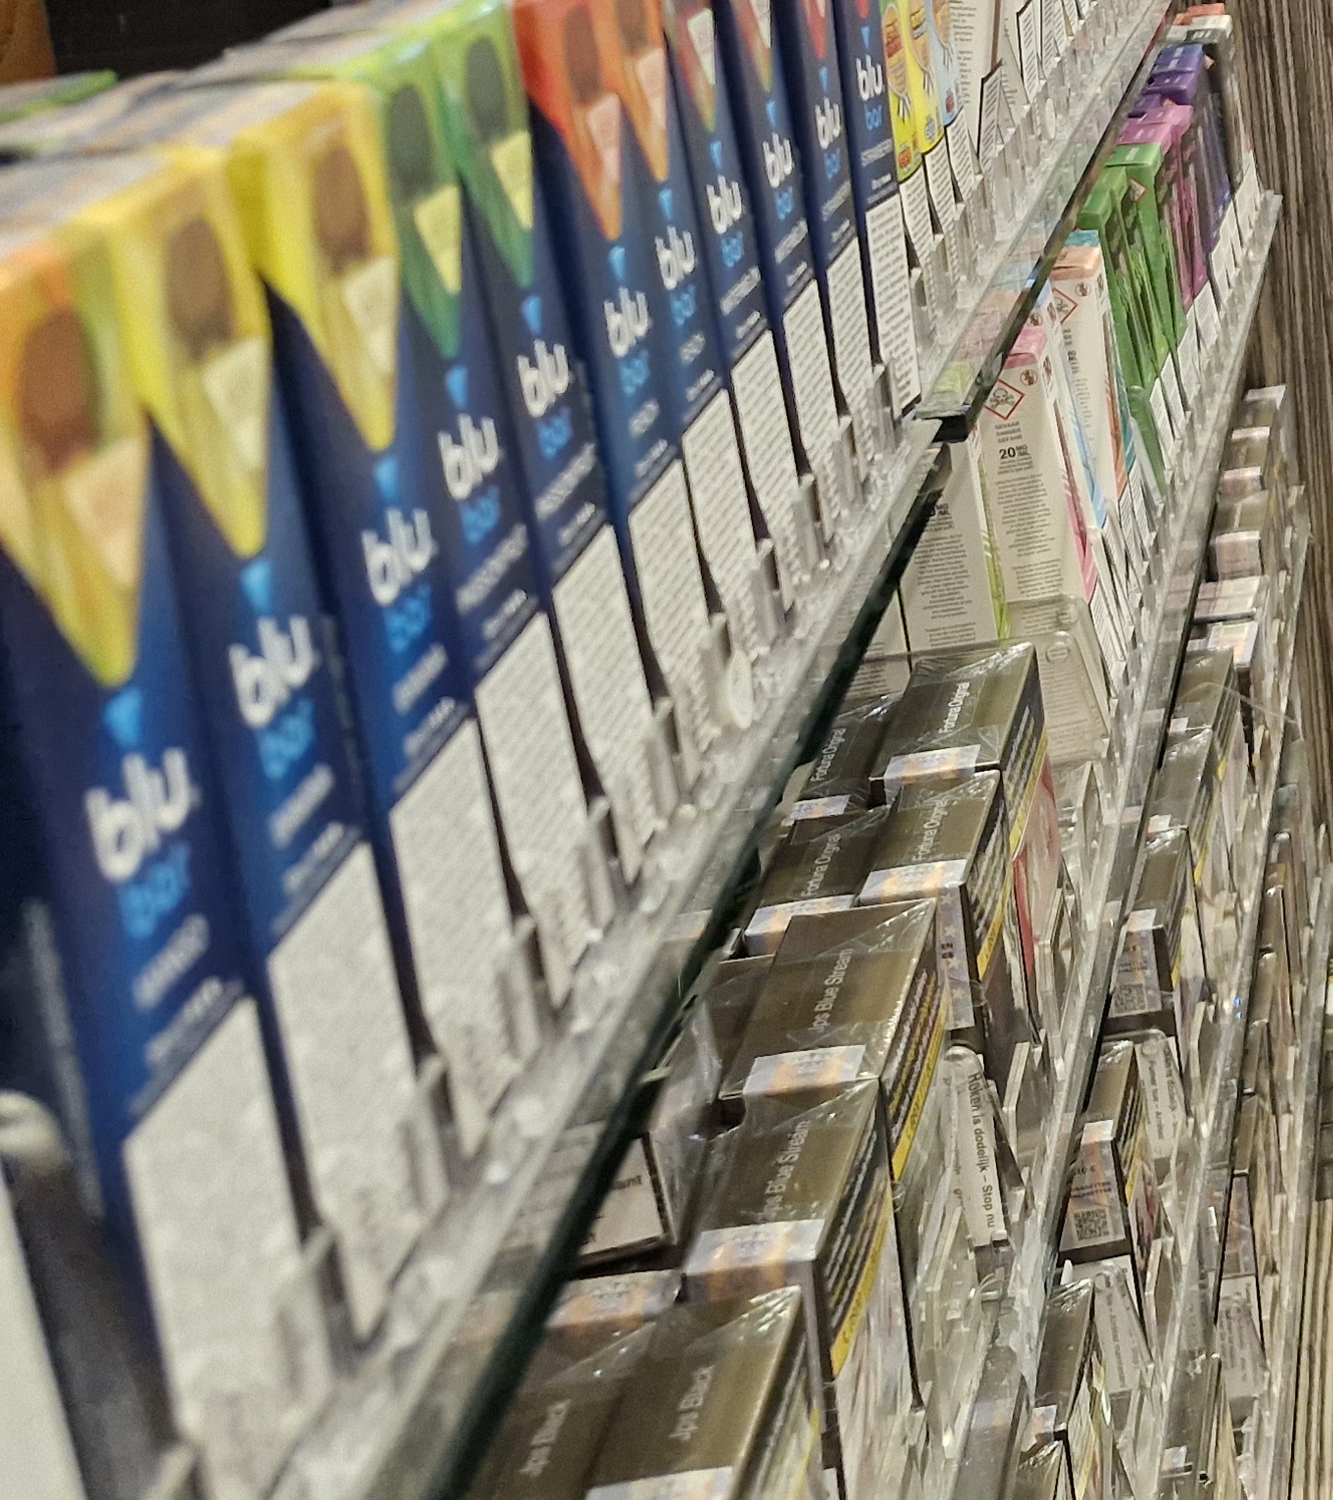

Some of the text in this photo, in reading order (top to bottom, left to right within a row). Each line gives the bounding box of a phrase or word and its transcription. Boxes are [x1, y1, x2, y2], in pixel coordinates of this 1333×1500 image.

[855, 56, 886, 102] blu
[815, 95, 844, 149] blu
[763, 123, 795, 188] blu
[707, 175, 744, 234] blu
[655, 226, 696, 290] blu
[604, 286, 651, 358] blu
[517, 338, 573, 418] blu
[437, 413, 502, 500] blu
[999, 448, 1017, 459] 20
[361, 508, 437, 606] blu
[967, 1072, 983, 1109] Roken
[972, 1128, 989, 1173] dodelijk
[981, 1184, 994, 1212] Stop
[986, 1216, 997, 1229] nu
